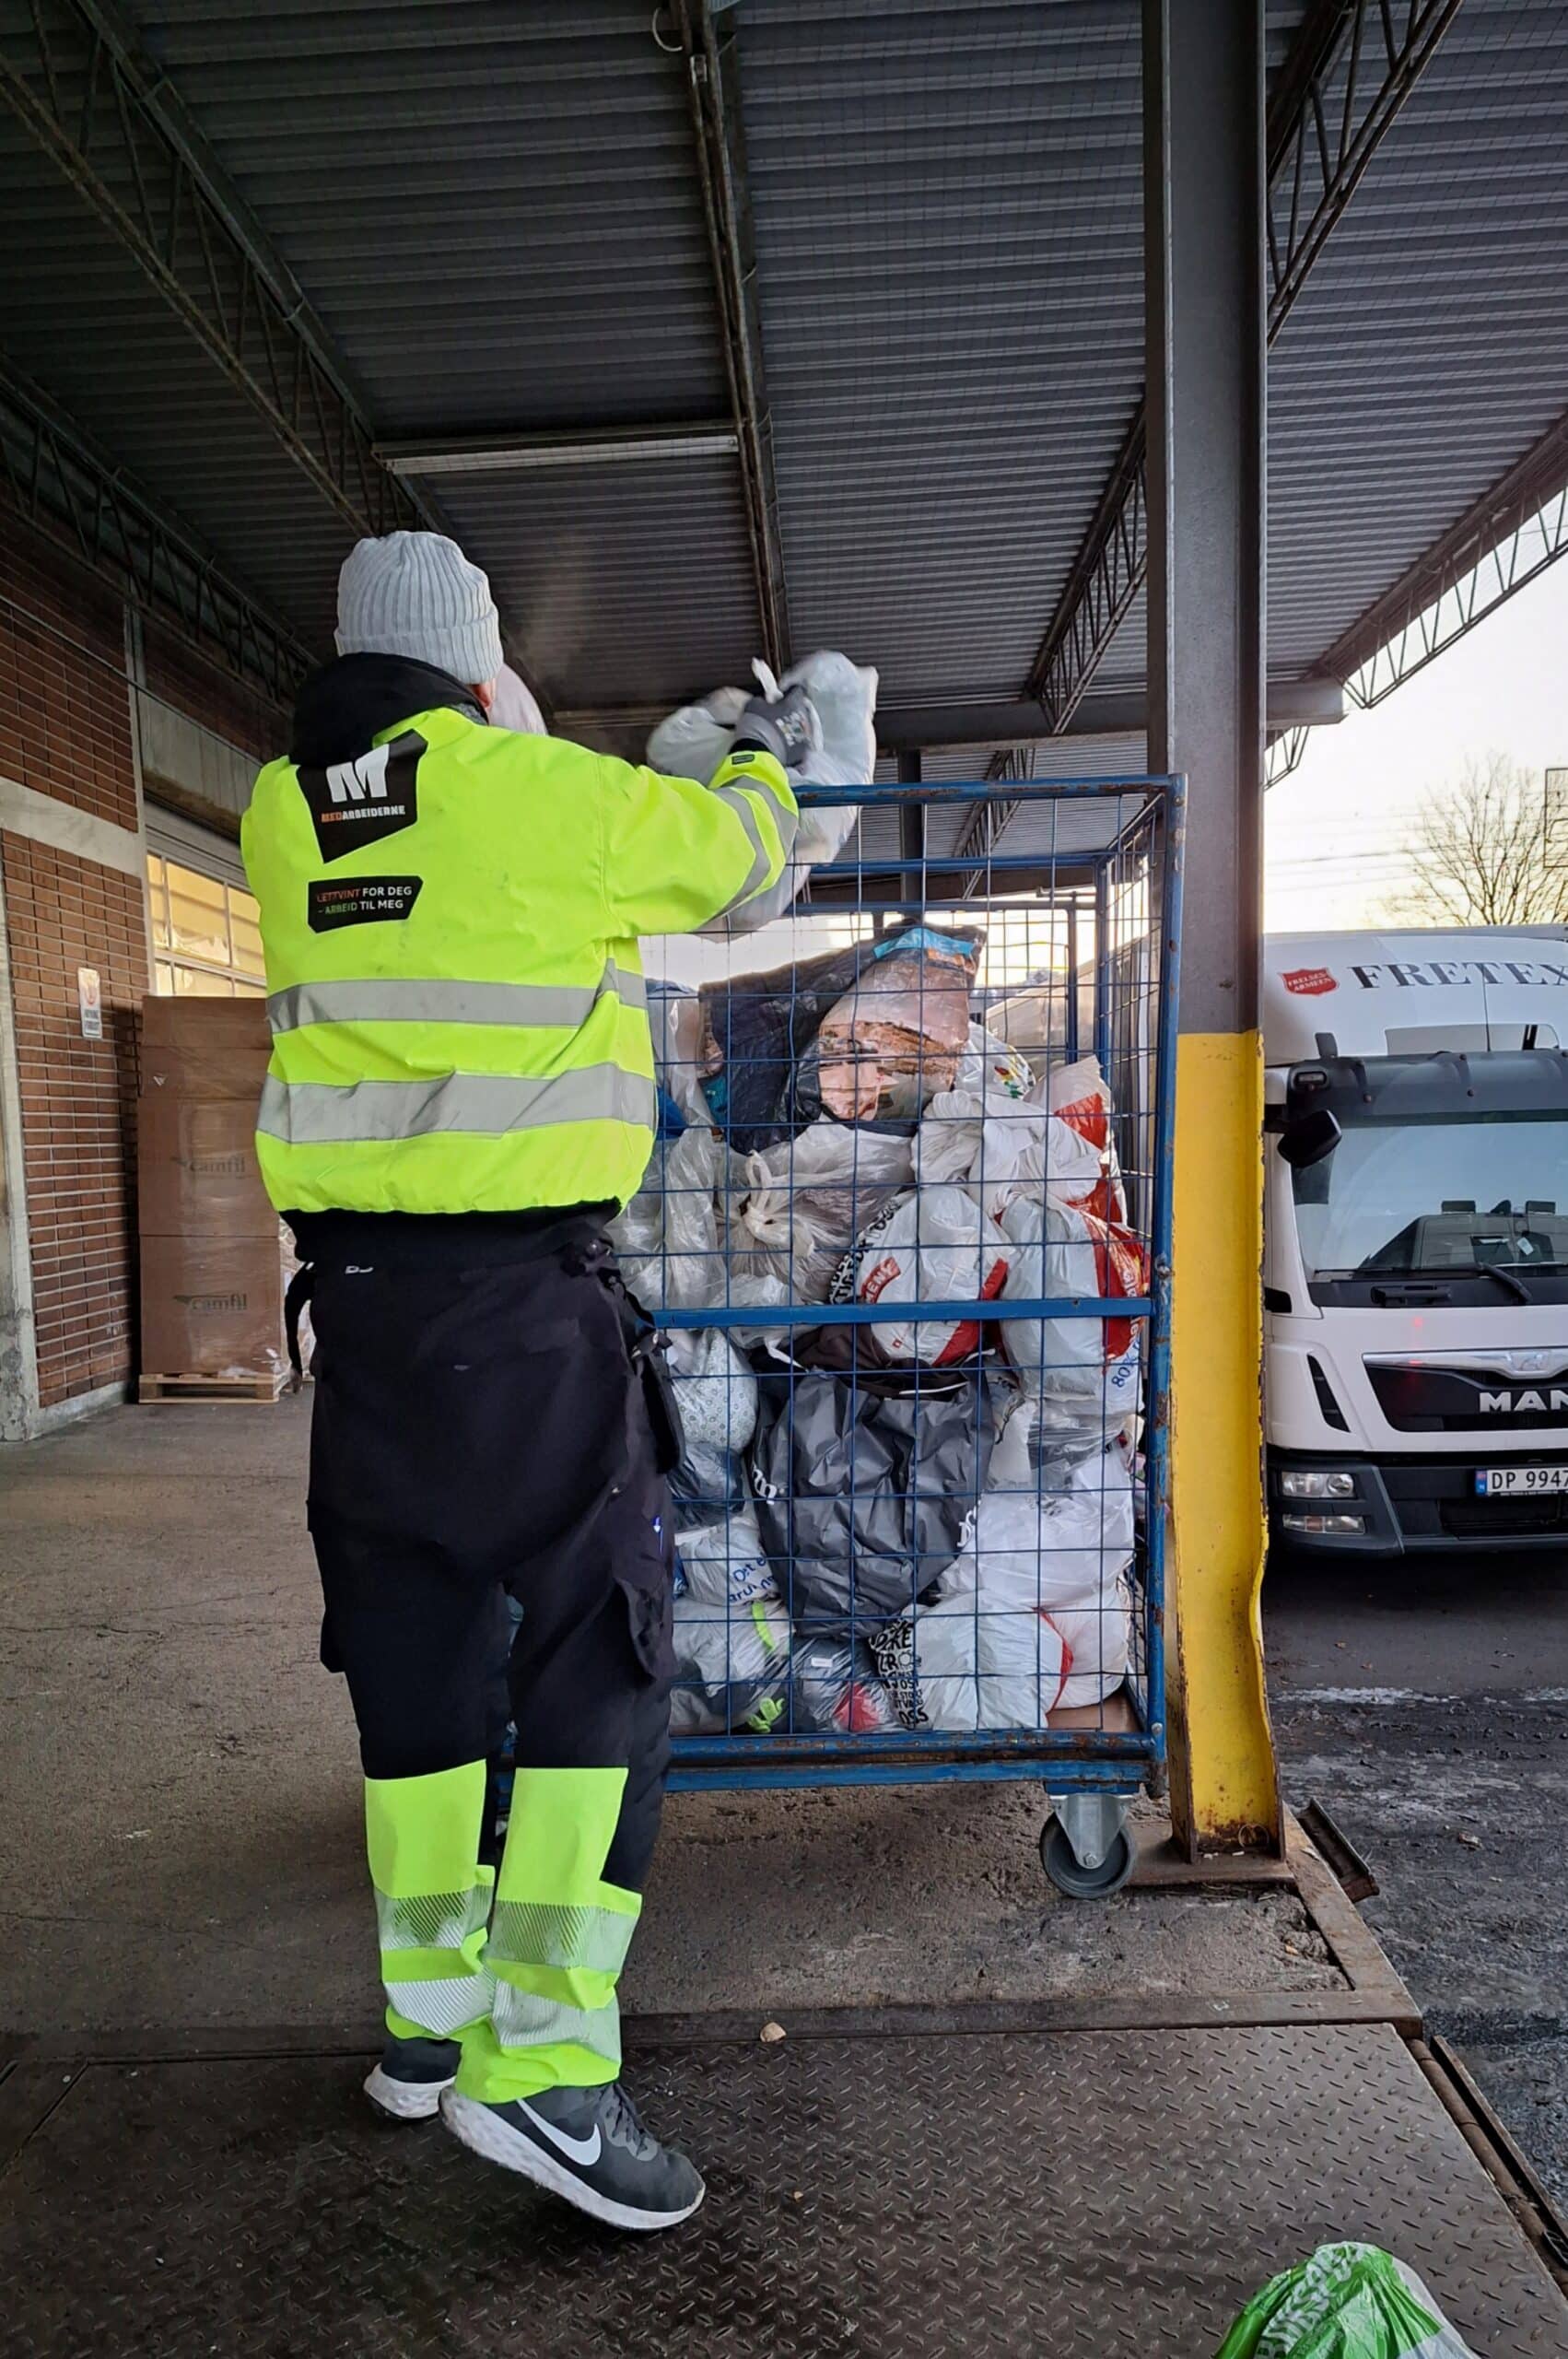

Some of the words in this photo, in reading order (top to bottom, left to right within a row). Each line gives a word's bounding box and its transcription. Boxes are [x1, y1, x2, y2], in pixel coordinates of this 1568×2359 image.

[362, 886, 384, 897] FOR
[387, 886, 412, 896] DEG
[359, 900, 376, 910] TIL
[378, 899, 404, 910] MEG
[1349, 962, 1568, 989] FRETEX
[192, 1294, 247, 1310] camfil
[1492, 1472, 1516, 1489] DP
